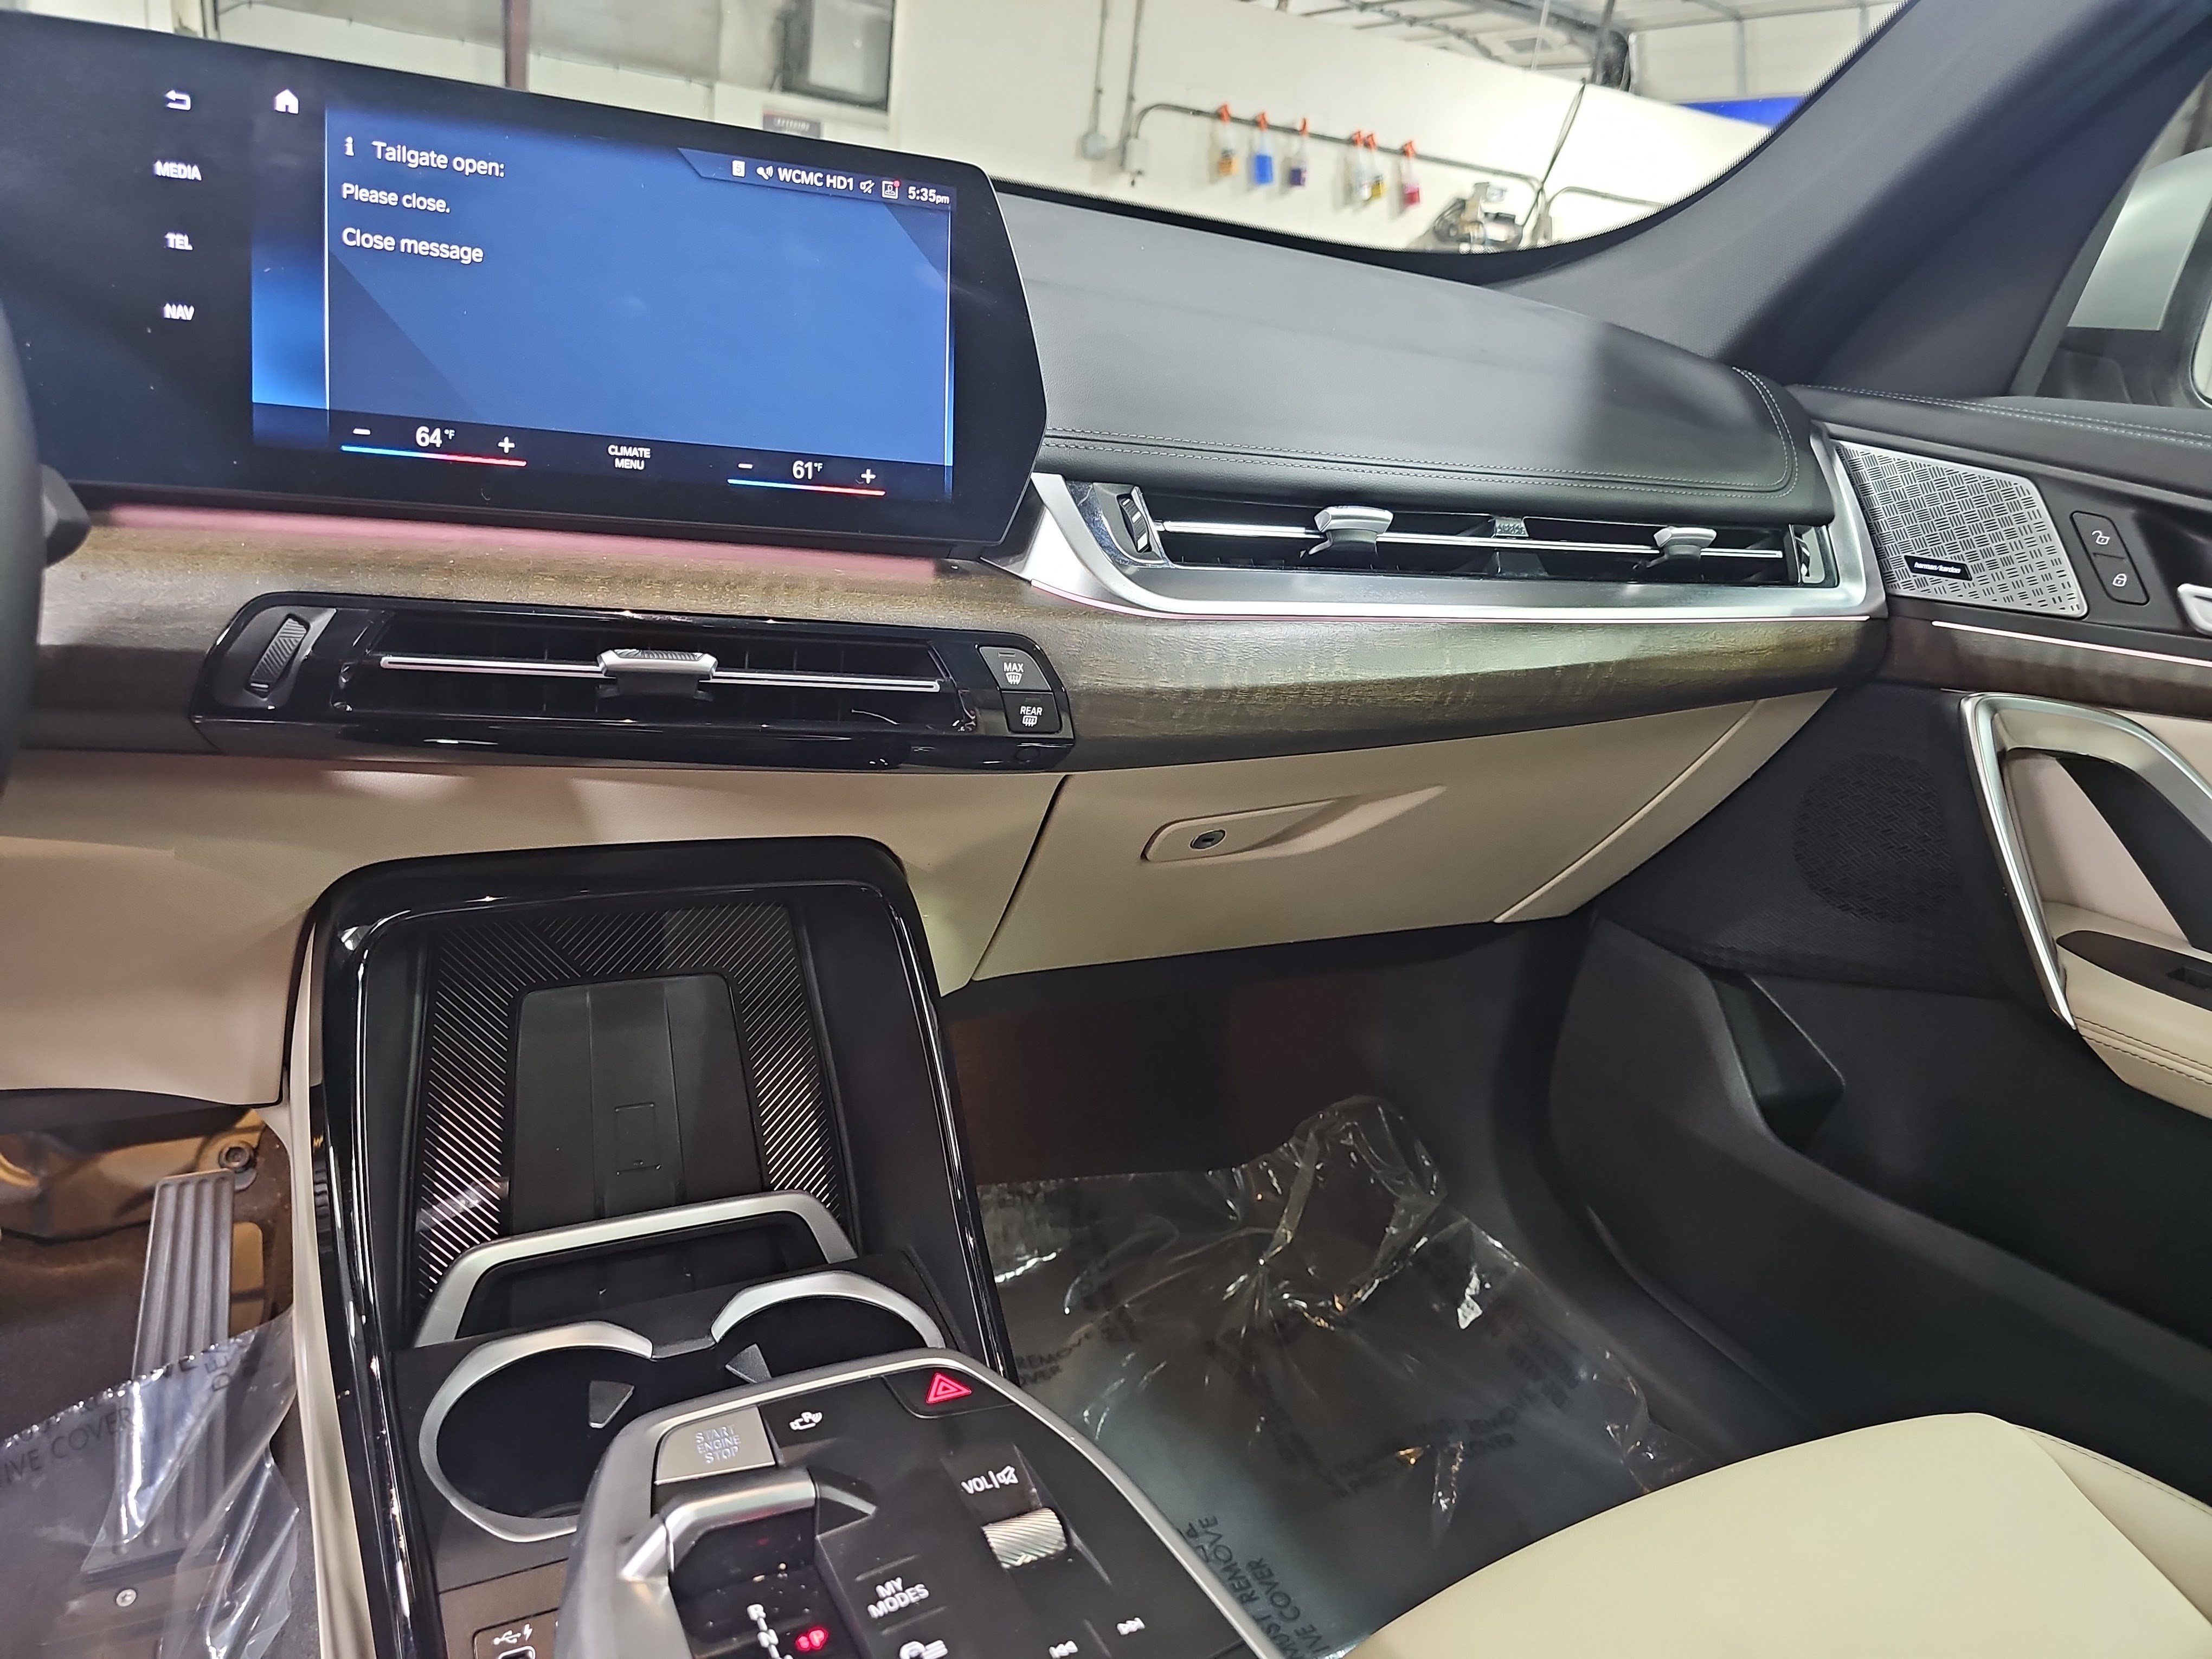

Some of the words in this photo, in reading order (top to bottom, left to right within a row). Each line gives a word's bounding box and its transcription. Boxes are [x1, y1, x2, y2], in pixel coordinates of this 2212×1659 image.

[372, 140, 448, 170] Tailgate
[452, 155, 505, 177] open:
[154, 160, 202, 182] MEDIA
[777, 167, 824, 187] WCMC
[826, 175, 853, 191] HD1
[908, 186, 950, 205] 5:35pm
[342, 183, 398, 206] Please
[402, 192, 451, 213] close.
[165, 232, 193, 251] TEL
[342, 228, 395, 251] Close
[400, 240, 484, 264] message
[163, 303, 195, 321] NAV
[607, 443, 651, 458] CLIMATE
[614, 458, 645, 471] MENU
[1004, 663, 1024, 673] MAX
[1020, 706, 1043, 716] REAR
[50, 1407, 133, 1459] COVER
[695, 1425, 736, 1443] START
[697, 1436, 741, 1454] ENGINE
[705, 1446, 740, 1464] STOP
[961, 1476, 992, 1495] VOL
[1198, 1515, 1261, 1604] REMOVE
[876, 1577, 903, 1599] MY
[1246, 1557, 1301, 1623] COVER
[867, 1583, 929, 1619] MODES
[747, 1604, 767, 1621] R
[757, 1629, 779, 1648] N
